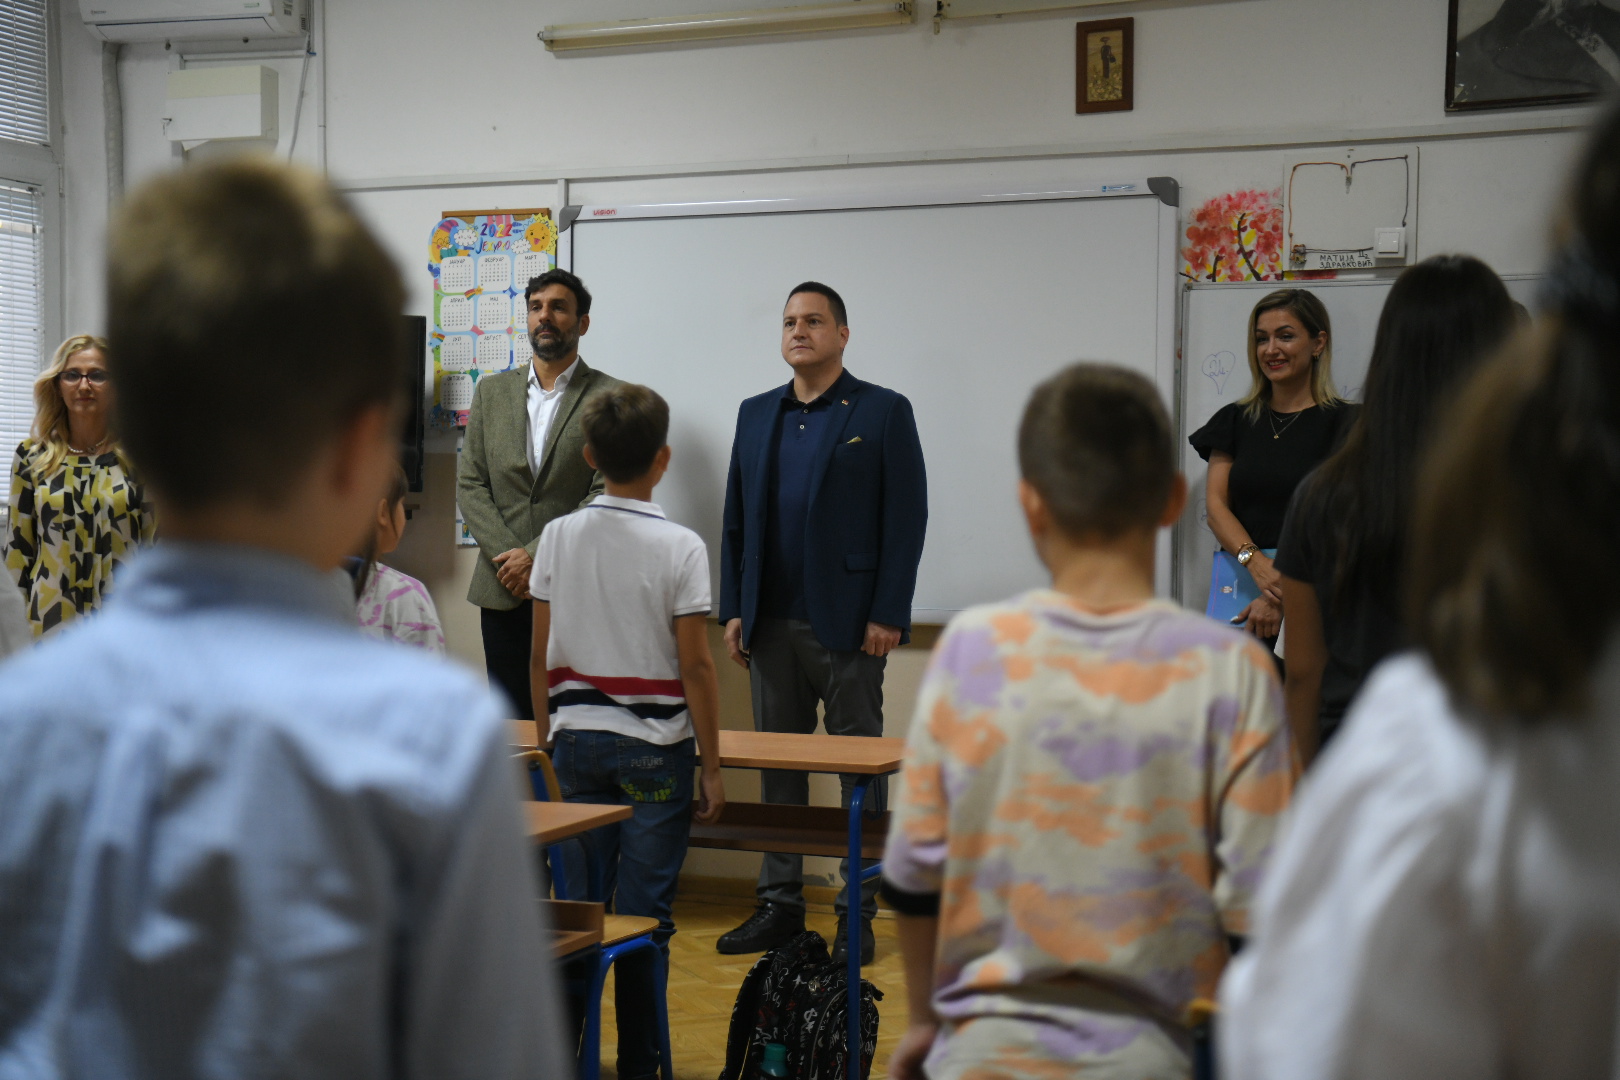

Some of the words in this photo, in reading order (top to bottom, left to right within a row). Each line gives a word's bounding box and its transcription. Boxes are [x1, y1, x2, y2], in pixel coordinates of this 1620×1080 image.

[480, 223, 513, 238] 2022
[1320, 254, 1355, 262] МАТИЈА
[1319, 259, 1374, 269] ЗДРАВКОВИЋ
[630, 756, 664, 767] FUTURE
